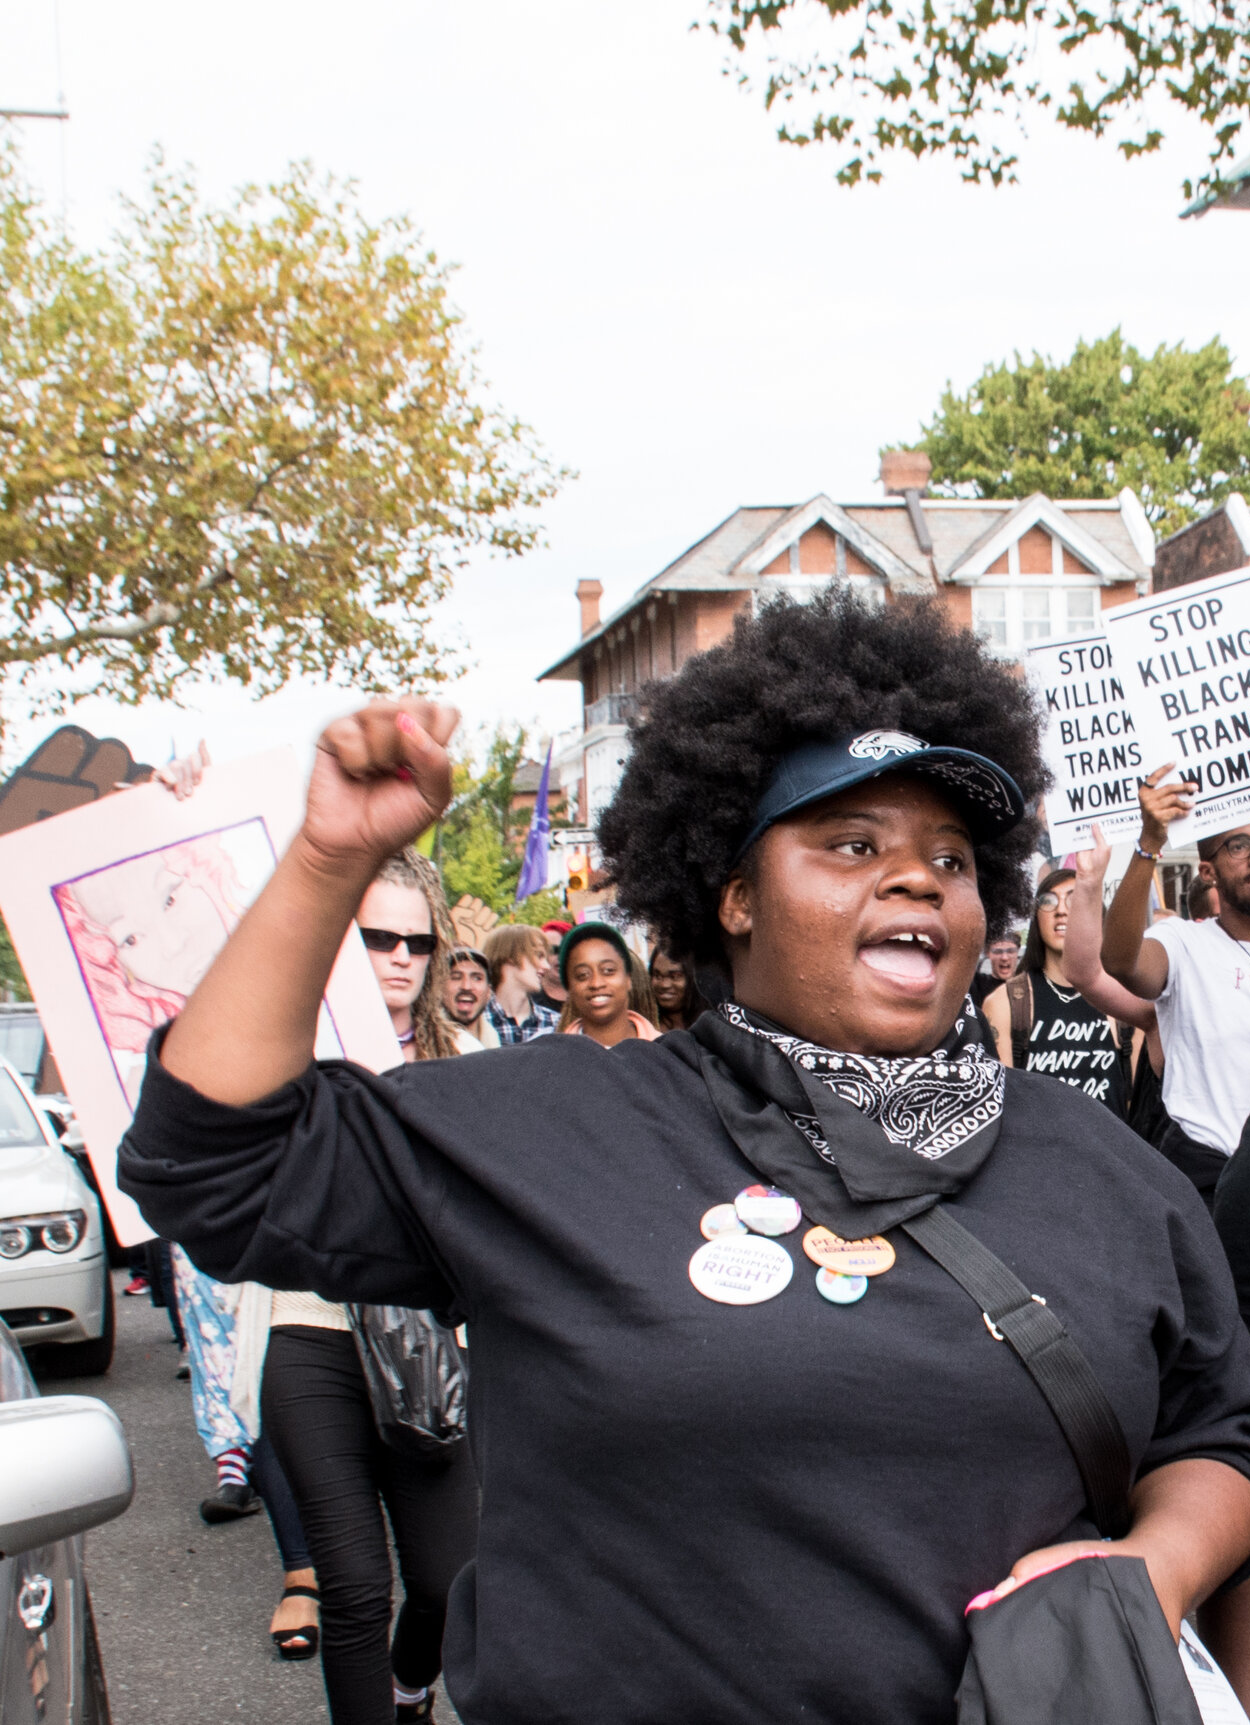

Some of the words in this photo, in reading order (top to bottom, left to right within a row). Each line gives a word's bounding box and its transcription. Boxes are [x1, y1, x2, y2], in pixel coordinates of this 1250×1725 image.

[1149, 598, 1225, 642] STOP
[1045, 678, 1124, 712] KILLIN
[1060, 710, 1135, 745] BLACK
[1065, 742, 1142, 778] TRANS
[1030, 1020, 1044, 1042] I
[1047, 1019, 1111, 1042] DON'T
[1026, 1050, 1090, 1073] WANT
[1091, 1050, 1115, 1070] TO
[714, 1244, 785, 1263] ABORTION
[730, 1256, 781, 1272] HUMAN
[702, 1261, 777, 1284] RIGHT
